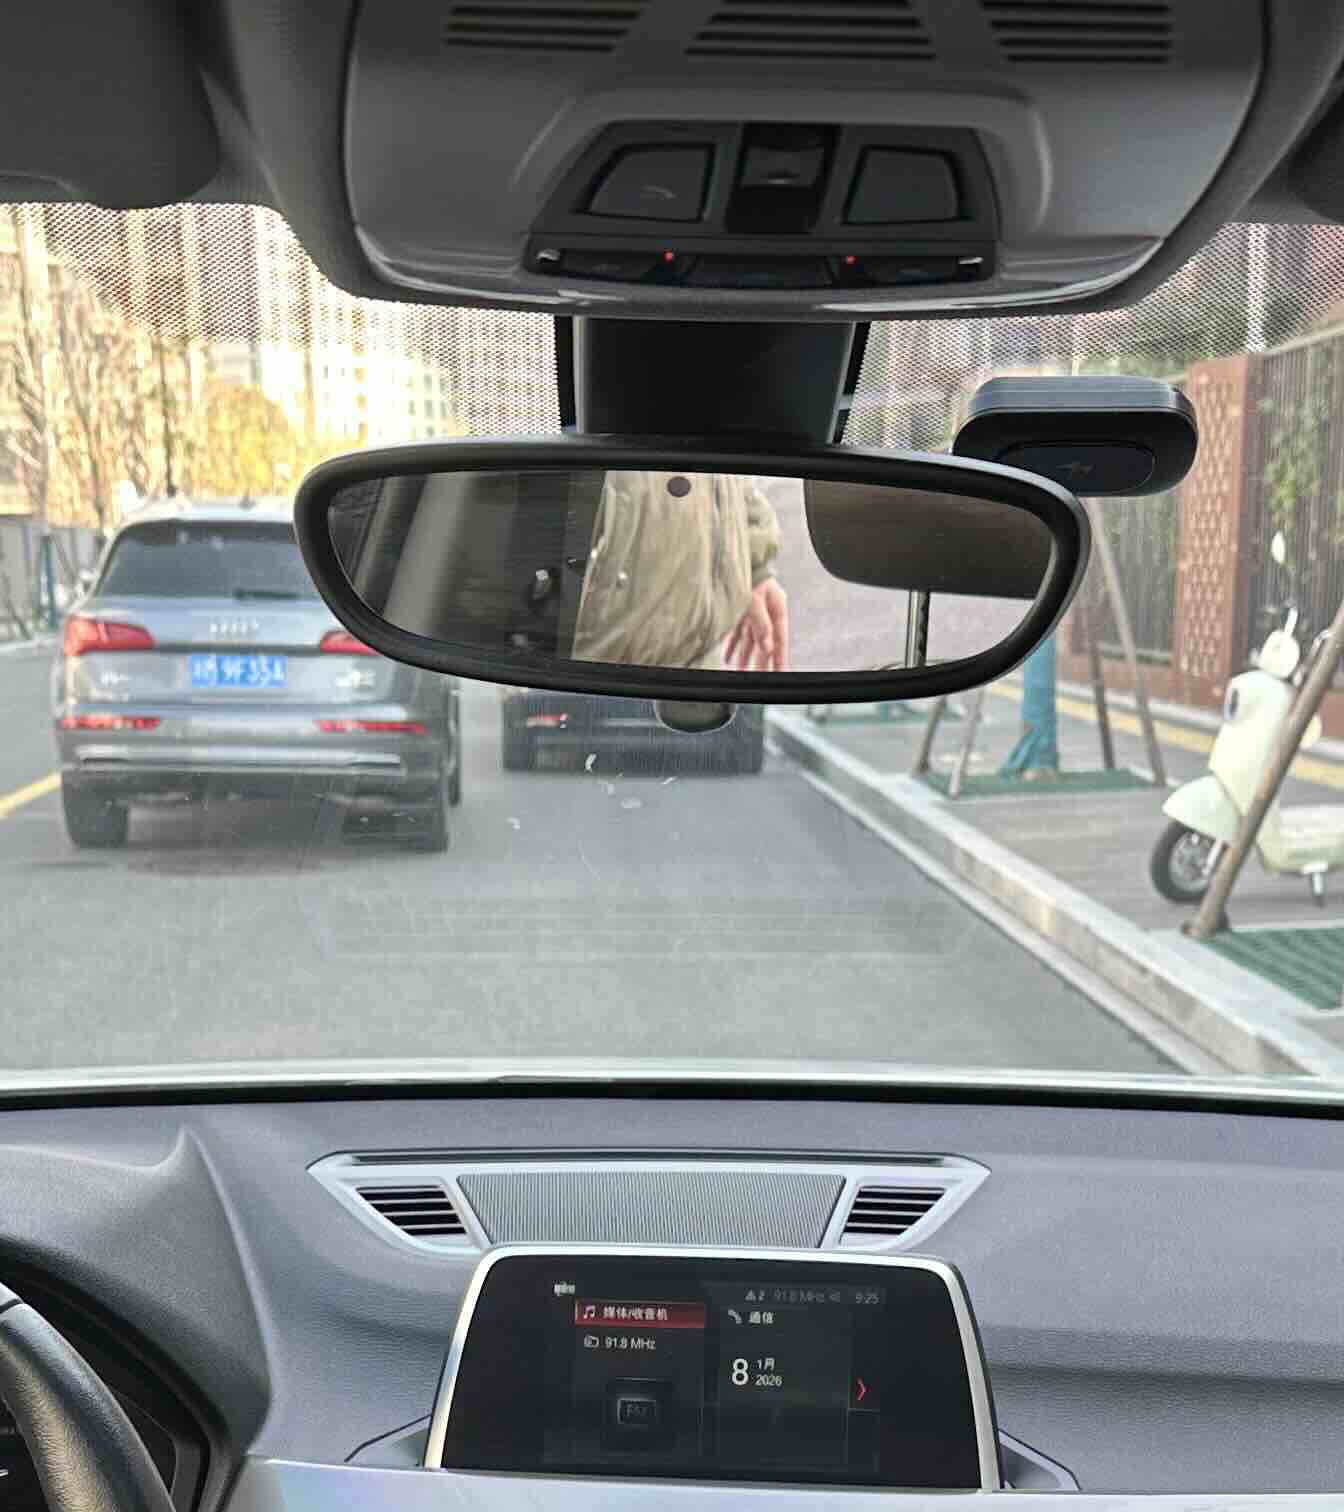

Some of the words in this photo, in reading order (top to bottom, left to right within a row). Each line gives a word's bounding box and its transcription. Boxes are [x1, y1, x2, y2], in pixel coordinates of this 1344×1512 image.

[630, 1337, 657, 1350] MHz
[757, 1357, 775, 1371] 1月
[731, 1357, 750, 1387] 8
[755, 1373, 783, 1387] 2026
